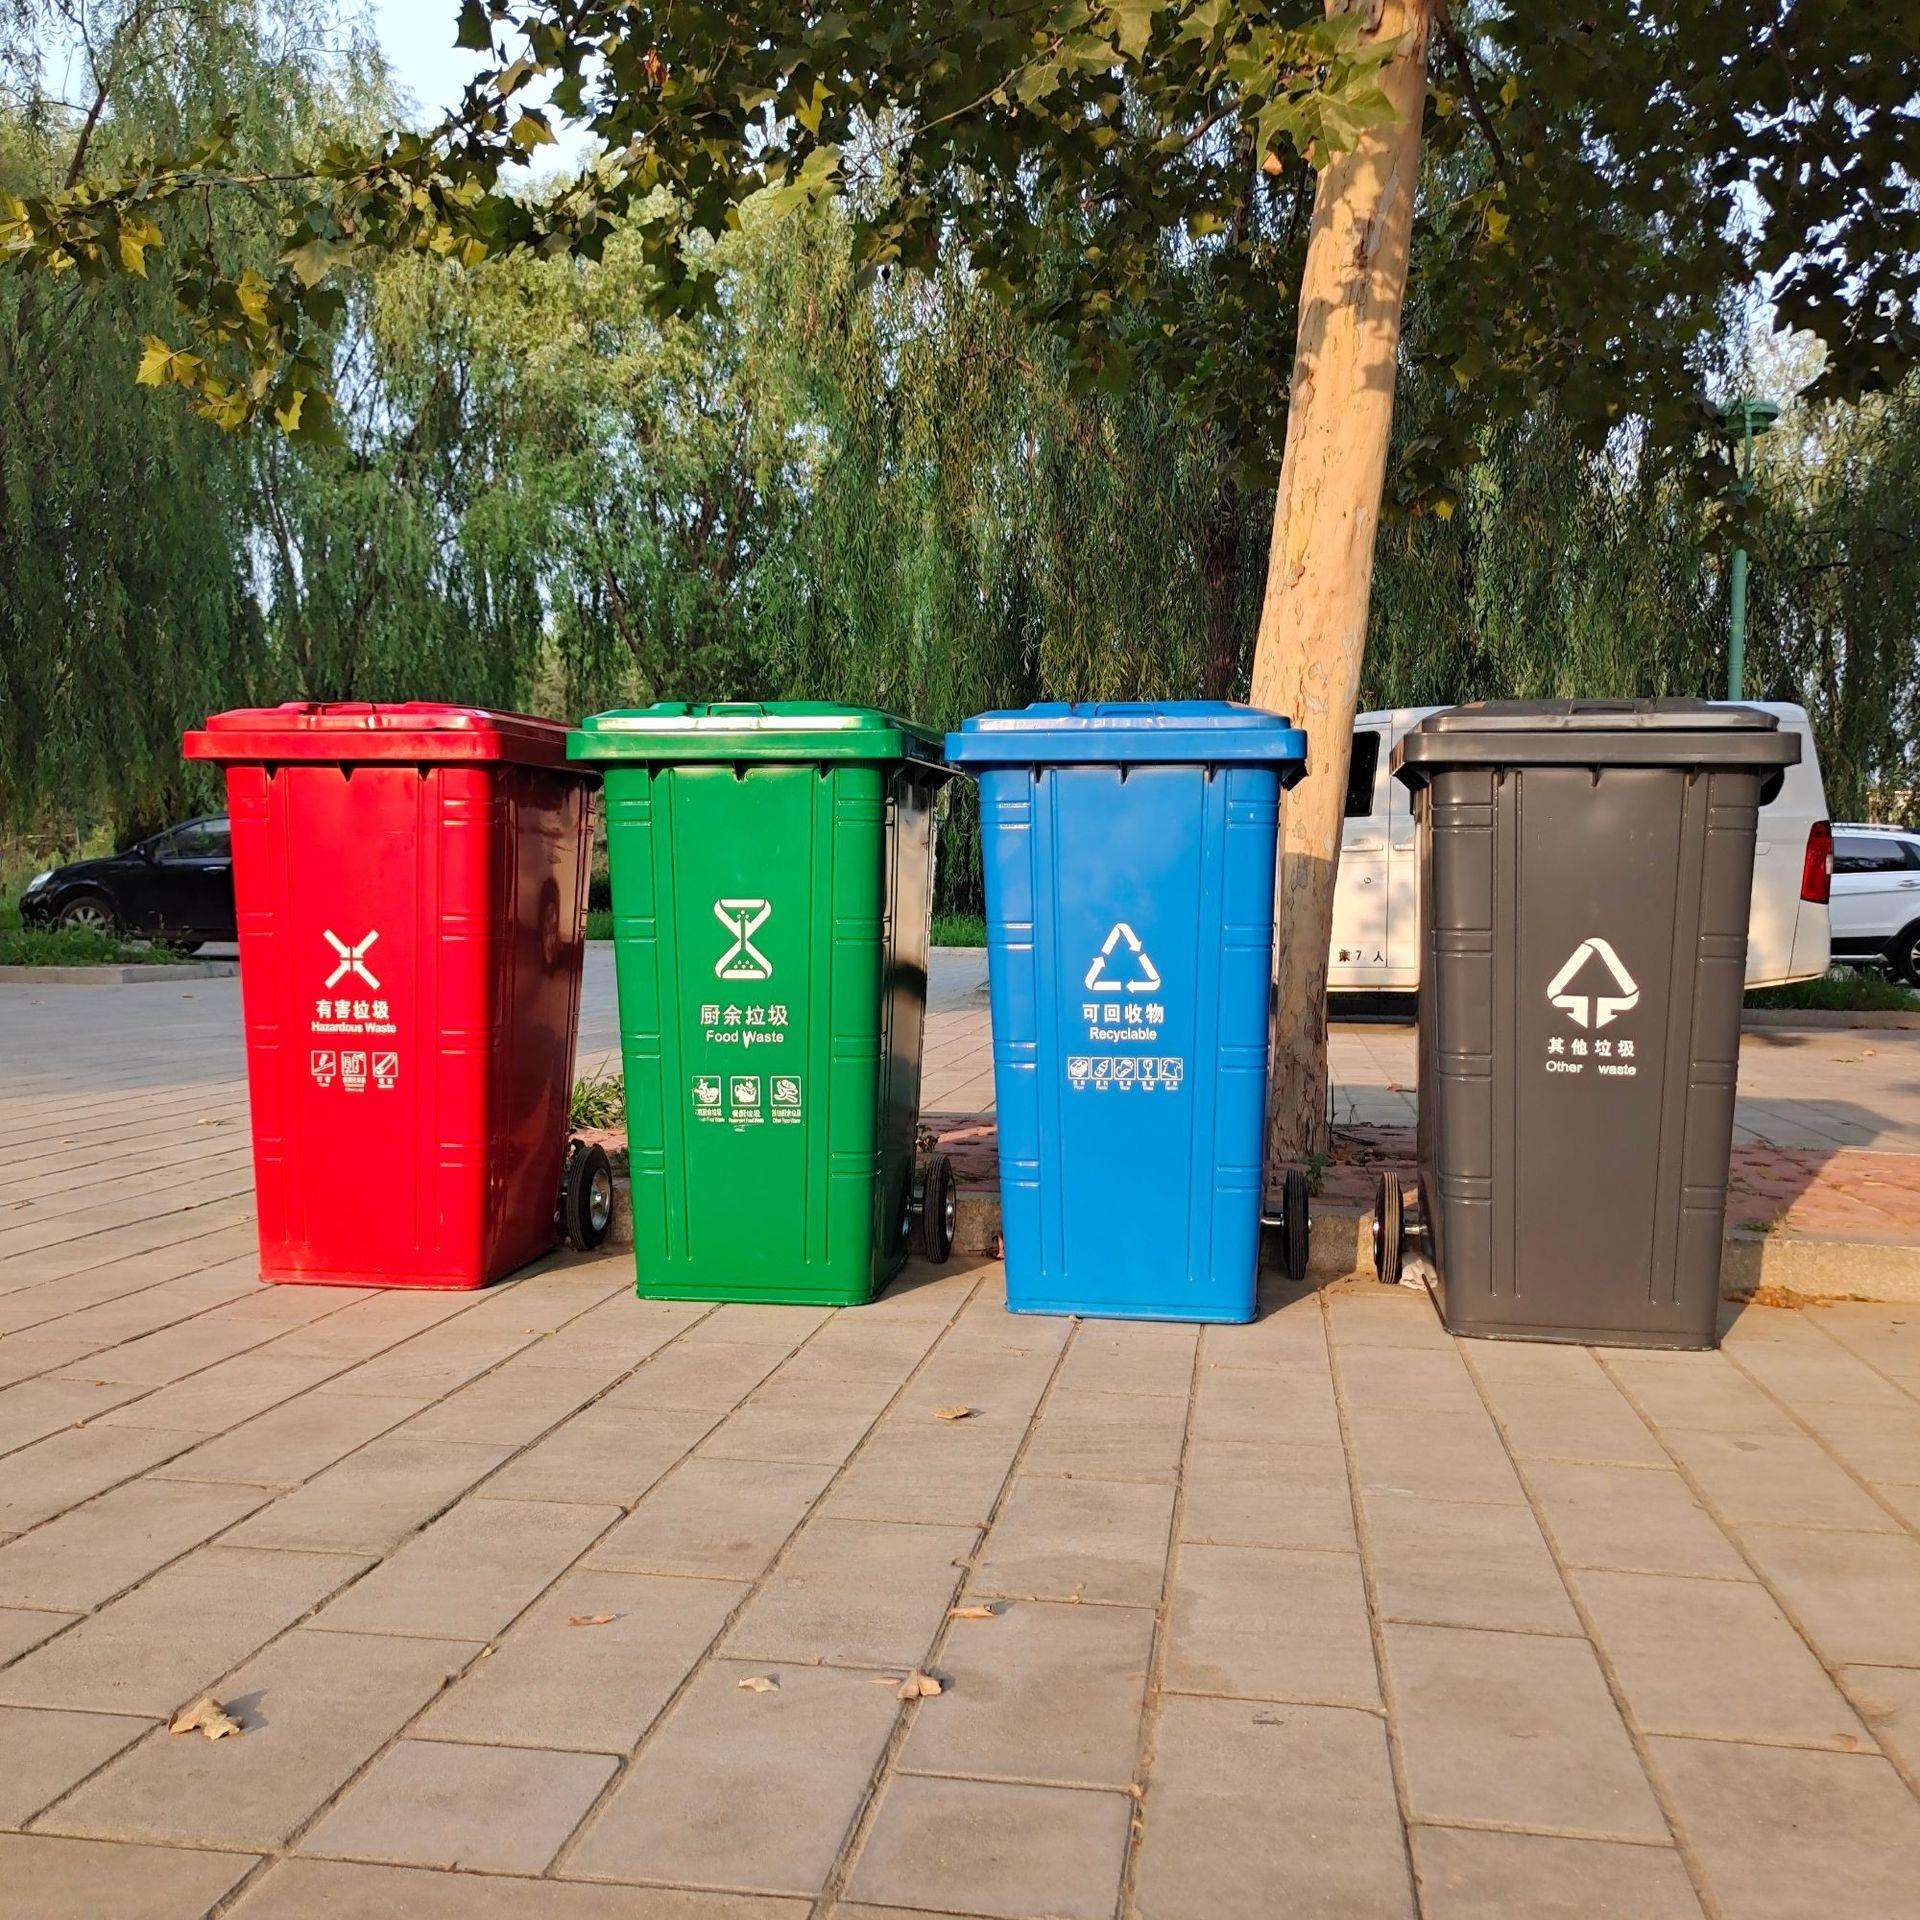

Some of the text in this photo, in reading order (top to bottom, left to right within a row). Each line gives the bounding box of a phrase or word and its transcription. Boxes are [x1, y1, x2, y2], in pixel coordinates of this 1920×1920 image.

[315, 999, 389, 1019] 有害垃圾
[700, 1004, 788, 1026] 厨余垃圾
[1082, 1003, 1164, 1023] 可回收物
[311, 1020, 397, 1034] Hazardous Waste
[1089, 1026, 1158, 1042] Recyclable
[706, 1030, 784, 1046] Food Waste
[1547, 1036, 1635, 1057] 其他垃圾
[1545, 1060, 1637, 1075] Other waste
